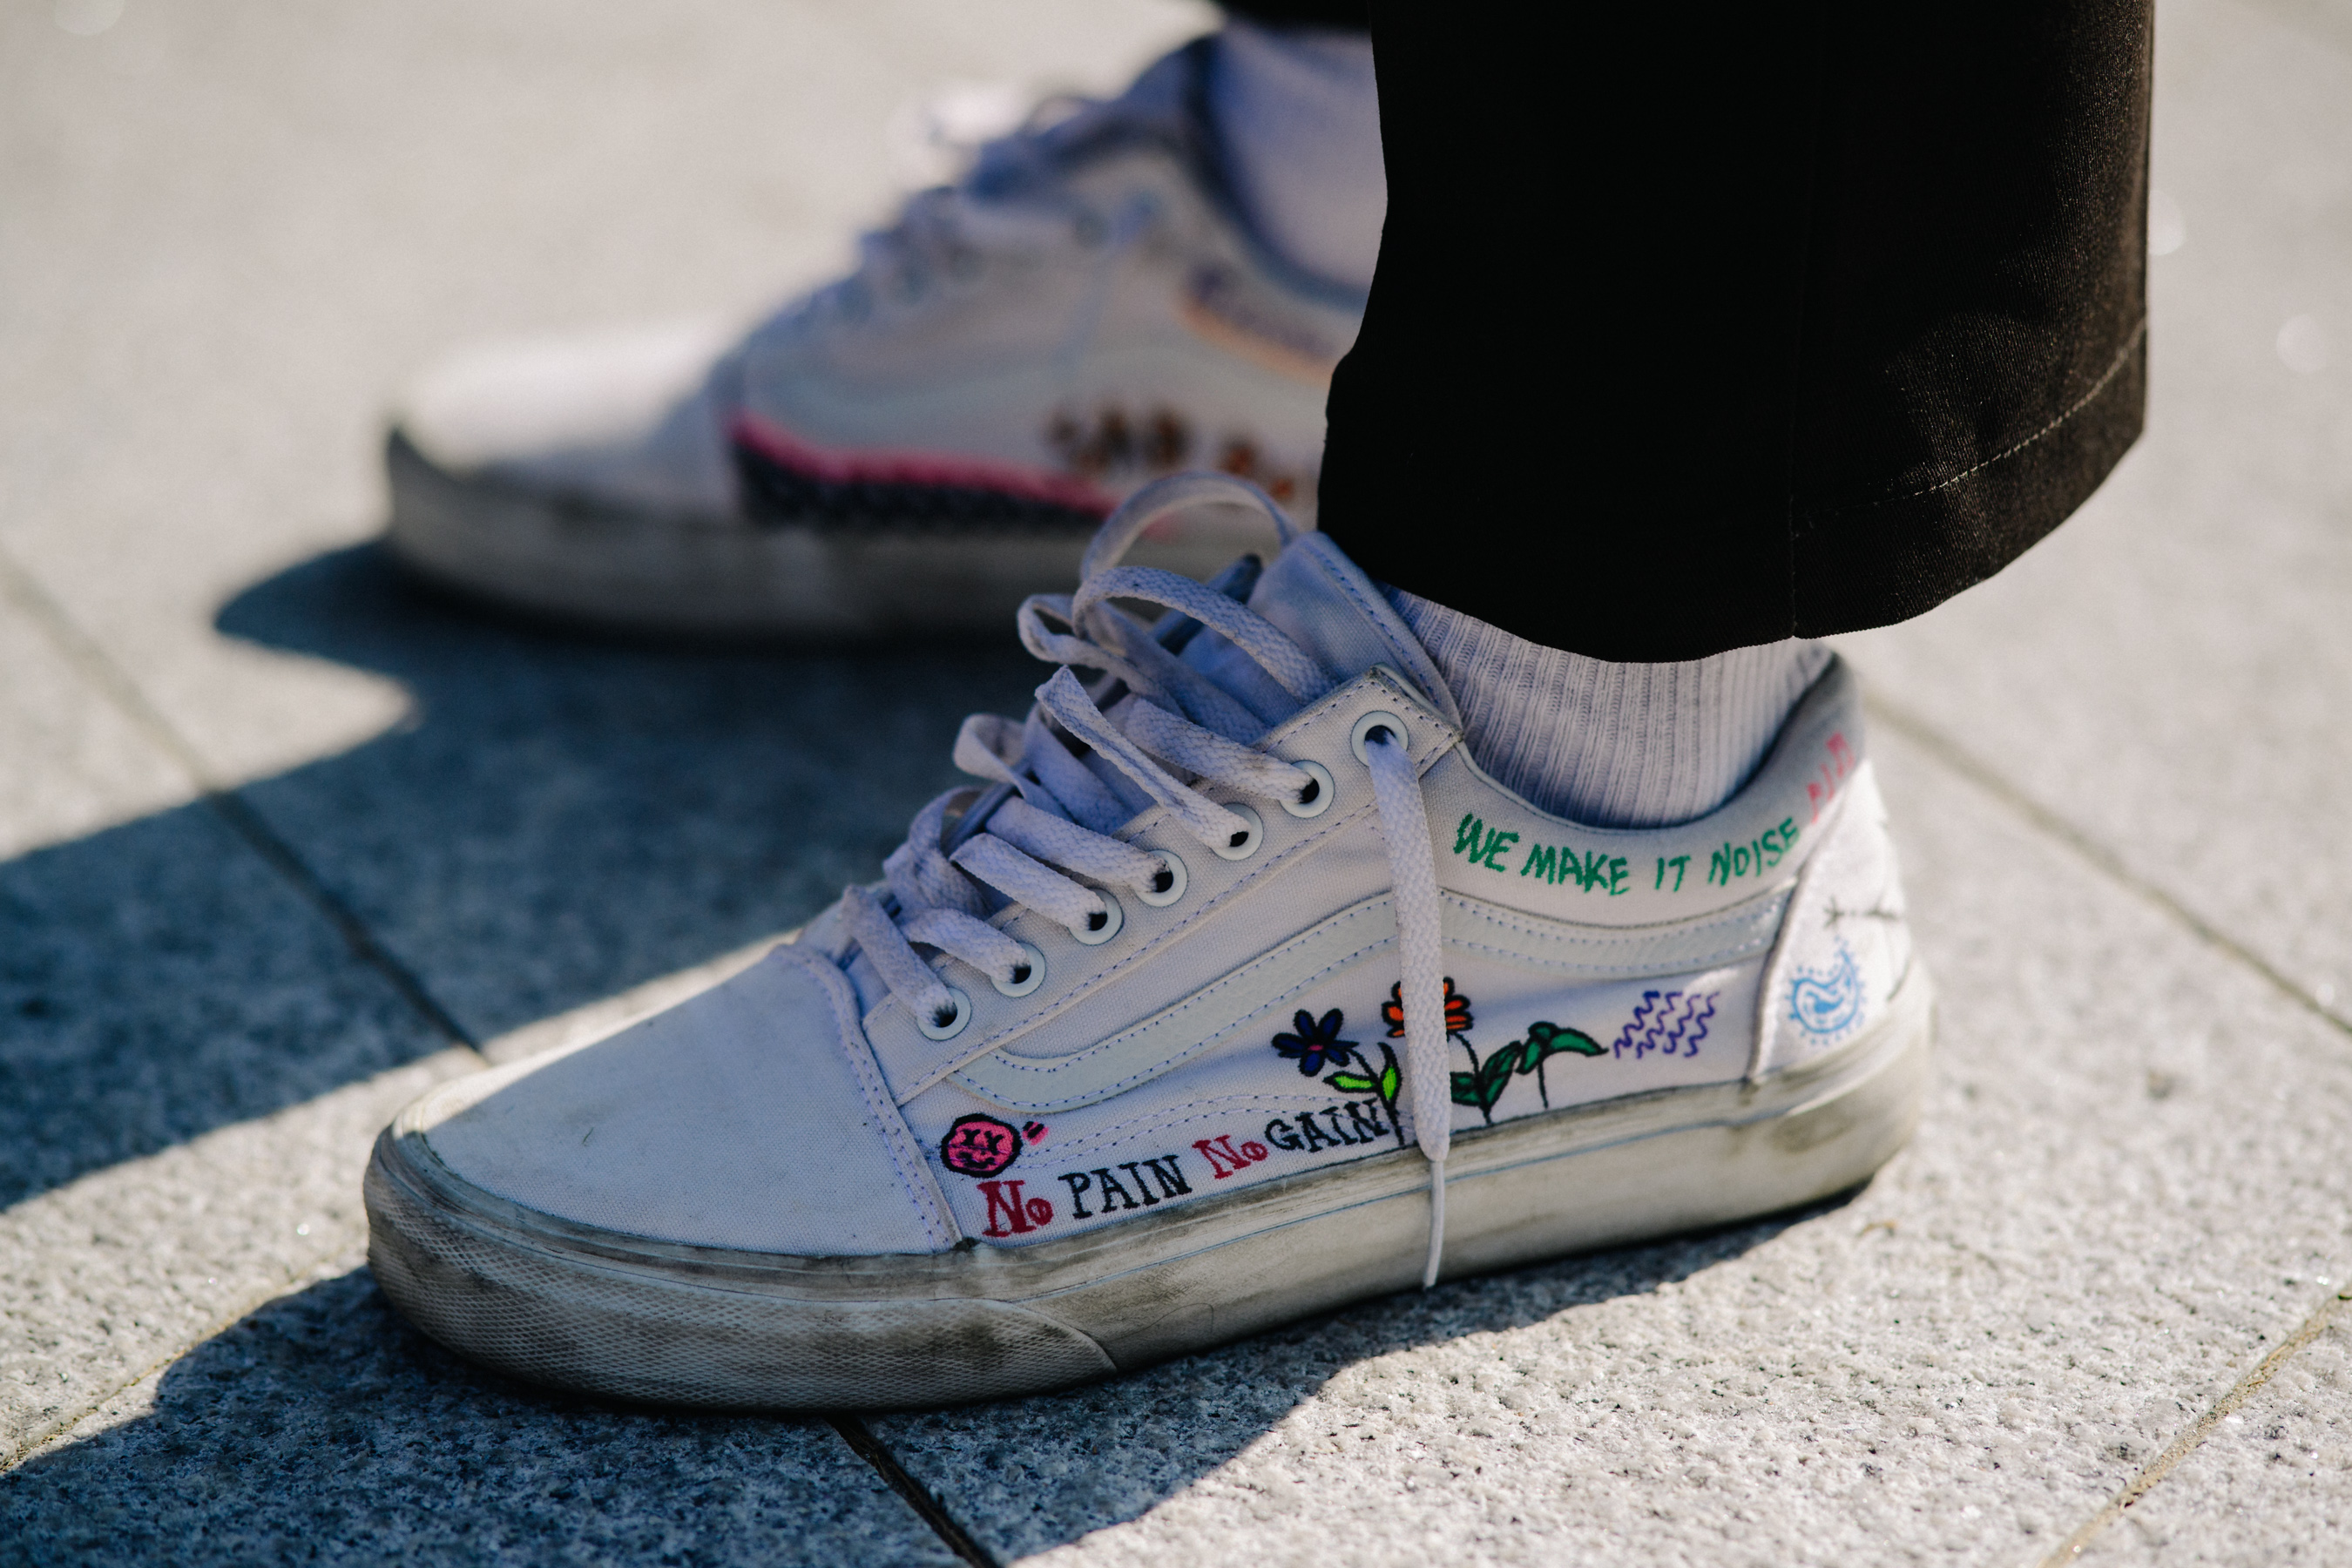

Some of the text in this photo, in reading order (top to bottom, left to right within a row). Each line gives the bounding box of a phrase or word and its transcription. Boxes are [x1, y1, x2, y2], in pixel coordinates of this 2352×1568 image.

[1453, 813, 1800, 896] WE MAKE IT NOISE
[1058, 1155, 1193, 1219] PAIN
[1265, 1098, 1389, 1152] GAIN
